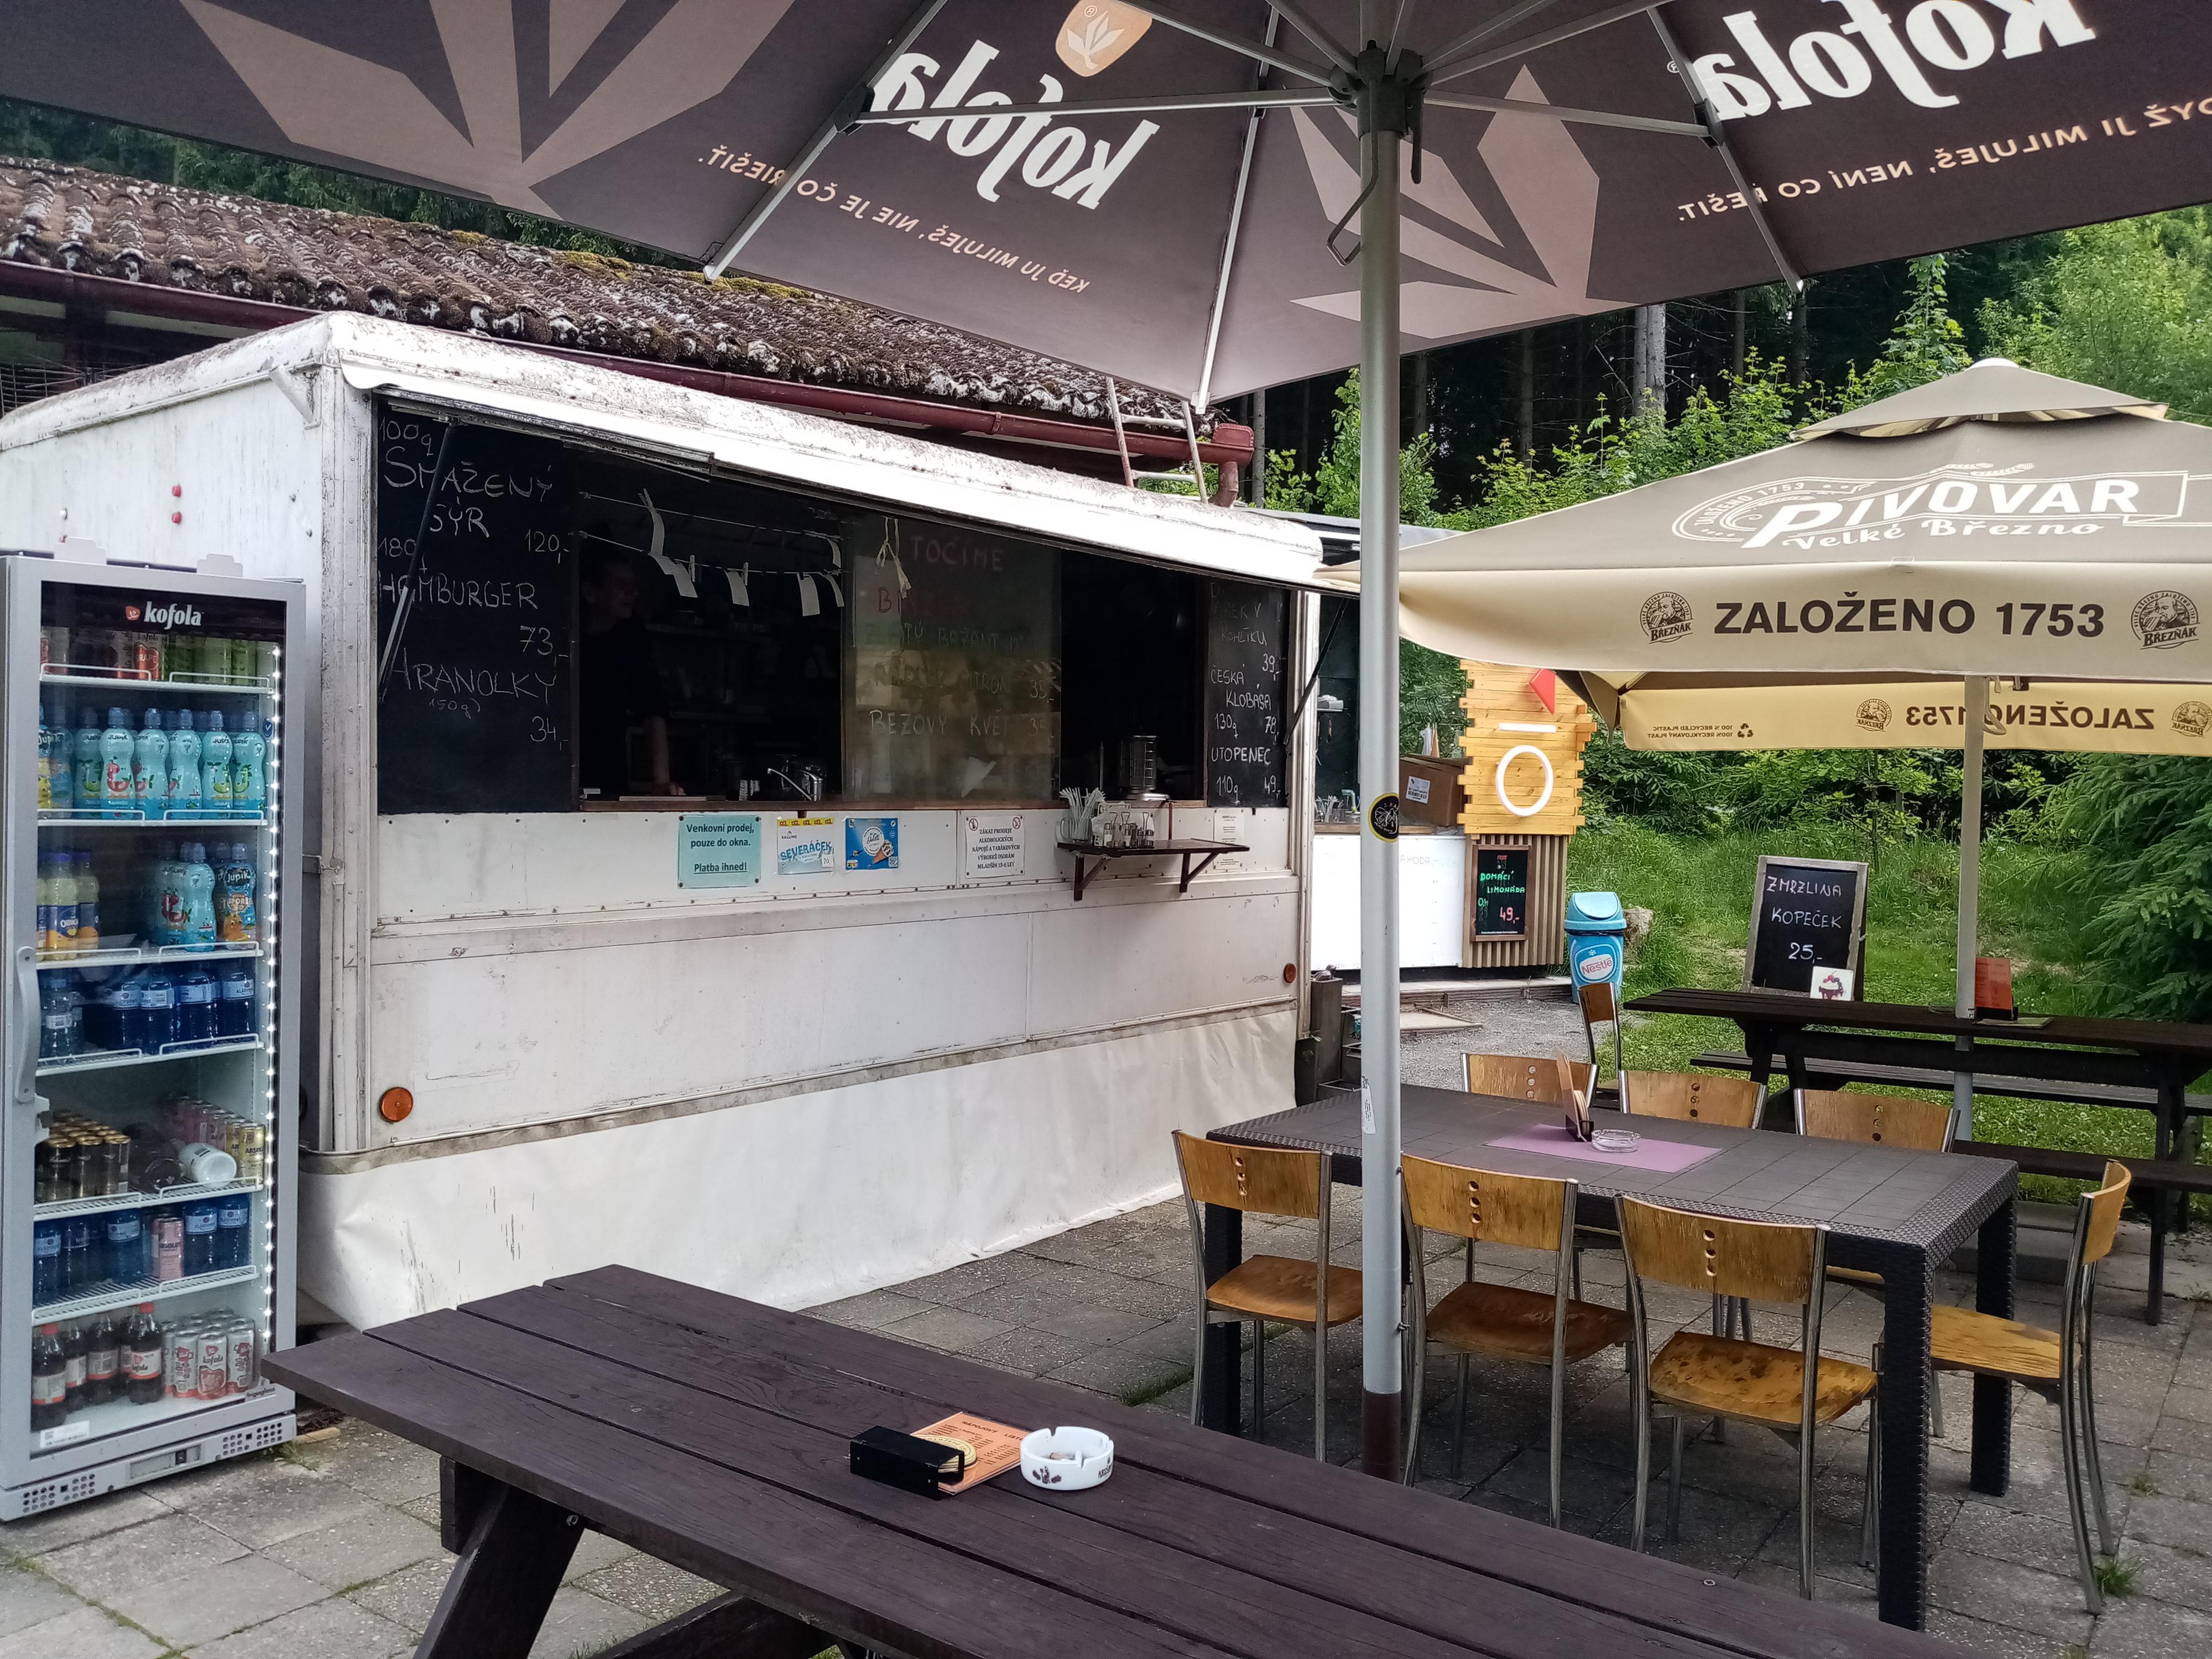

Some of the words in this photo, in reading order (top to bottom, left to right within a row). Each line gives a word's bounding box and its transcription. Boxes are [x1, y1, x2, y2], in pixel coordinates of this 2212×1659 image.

[1757, 482, 1805, 497] 1753
[1740, 478, 2140, 549] PIVOVAR
[1782, 523, 1906, 550] Velké
[1921, 517, 2105, 537] Březno
[144, 601, 202, 630] kofola
[1713, 591, 1976, 635] ZALOŽENO
[1996, 602, 2105, 638] 1753
[1211, 746, 1272, 765] UTOPENEC
[686, 823, 725, 832] Venkovní
[727, 823, 754, 834] prodej,
[691, 840, 715, 849] pouze
[717, 838, 727, 846] do
[729, 837, 751, 846] okna.
[780, 839, 832, 860] SEVERÁČEK
[694, 863, 719, 872] Platba
[722, 862, 747, 871] ihned!
[1480, 870, 1515, 881] DOMÁCÍ
[1487, 885, 1525, 894] LIMONÁDA
[1767, 875, 1842, 898] ZMRZLINA
[1771, 906, 1843, 930] KOPEČEK
